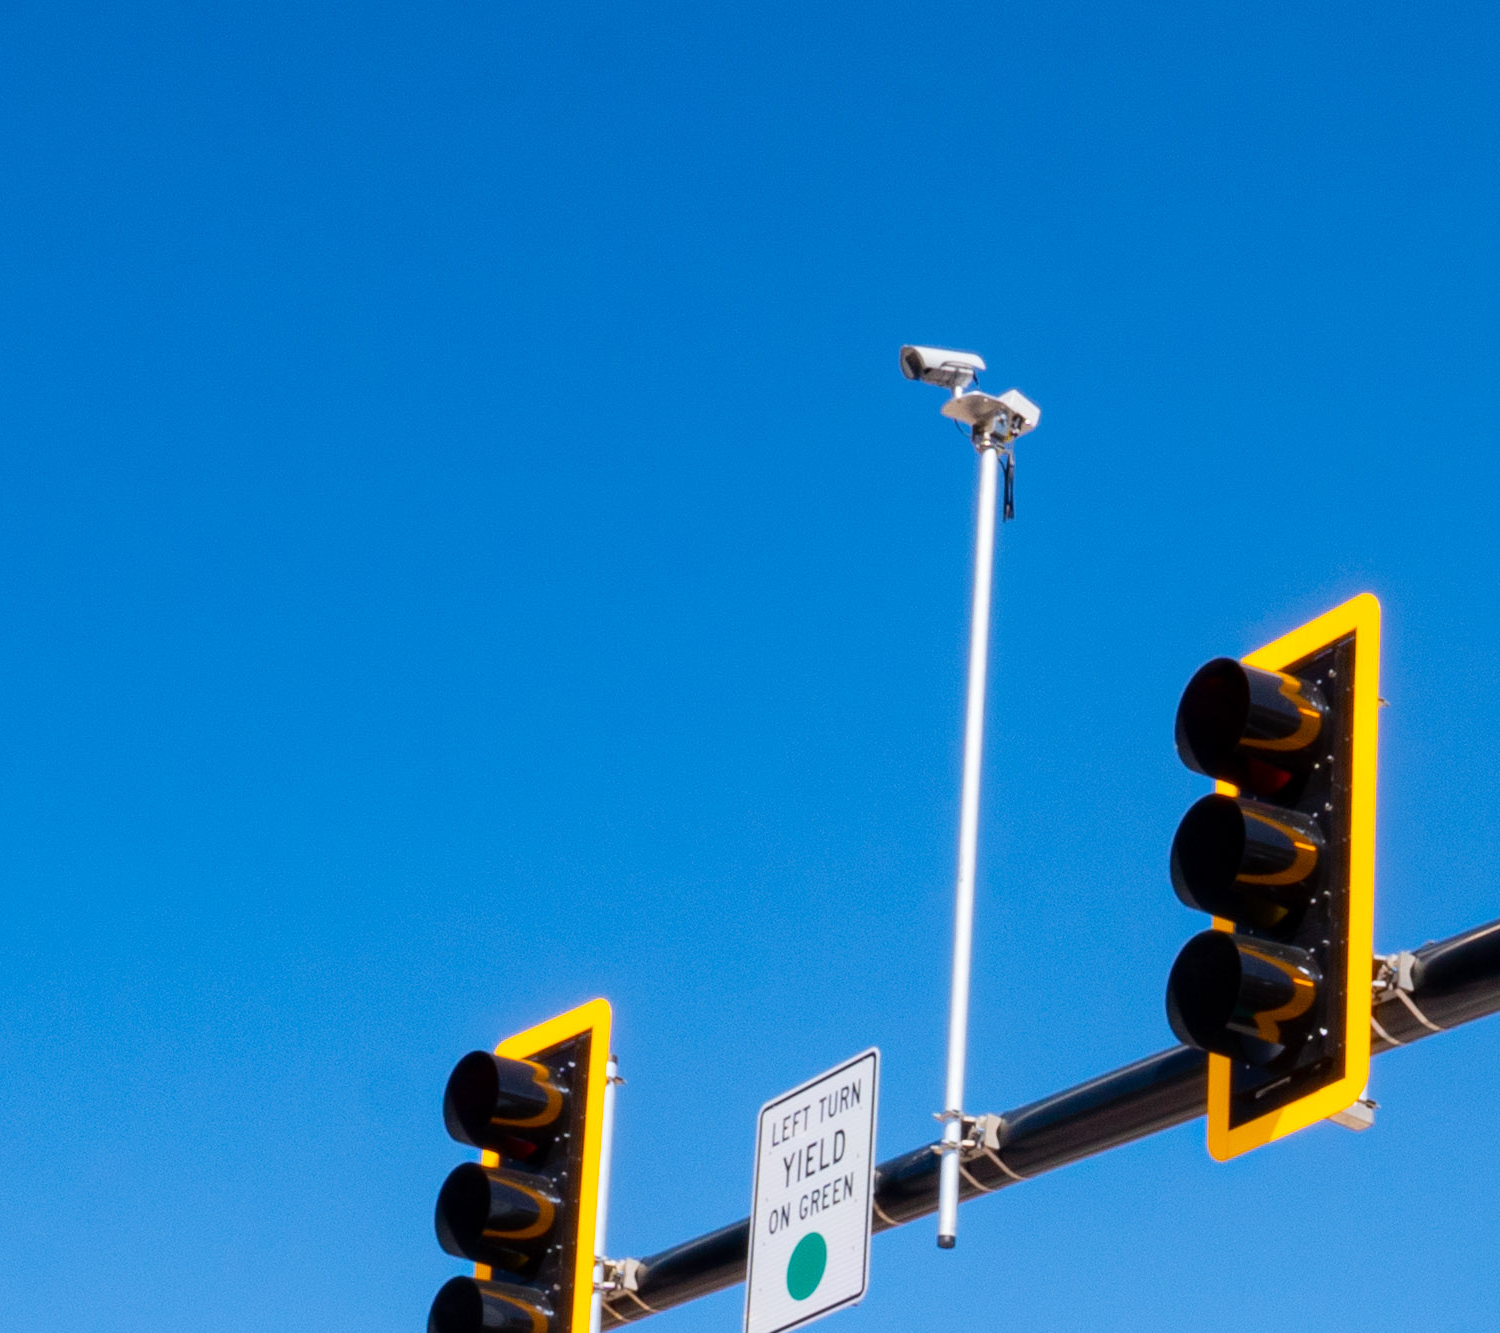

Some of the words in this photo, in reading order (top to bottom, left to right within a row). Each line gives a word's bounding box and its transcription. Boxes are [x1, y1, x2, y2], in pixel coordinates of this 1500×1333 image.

[772, 1105, 811, 1147] LEFT
[819, 1079, 861, 1123] TURN
[783, 1129, 846, 1188] YIELD
[769, 1202, 791, 1235] ON
[799, 1172, 854, 1220] GREEN
